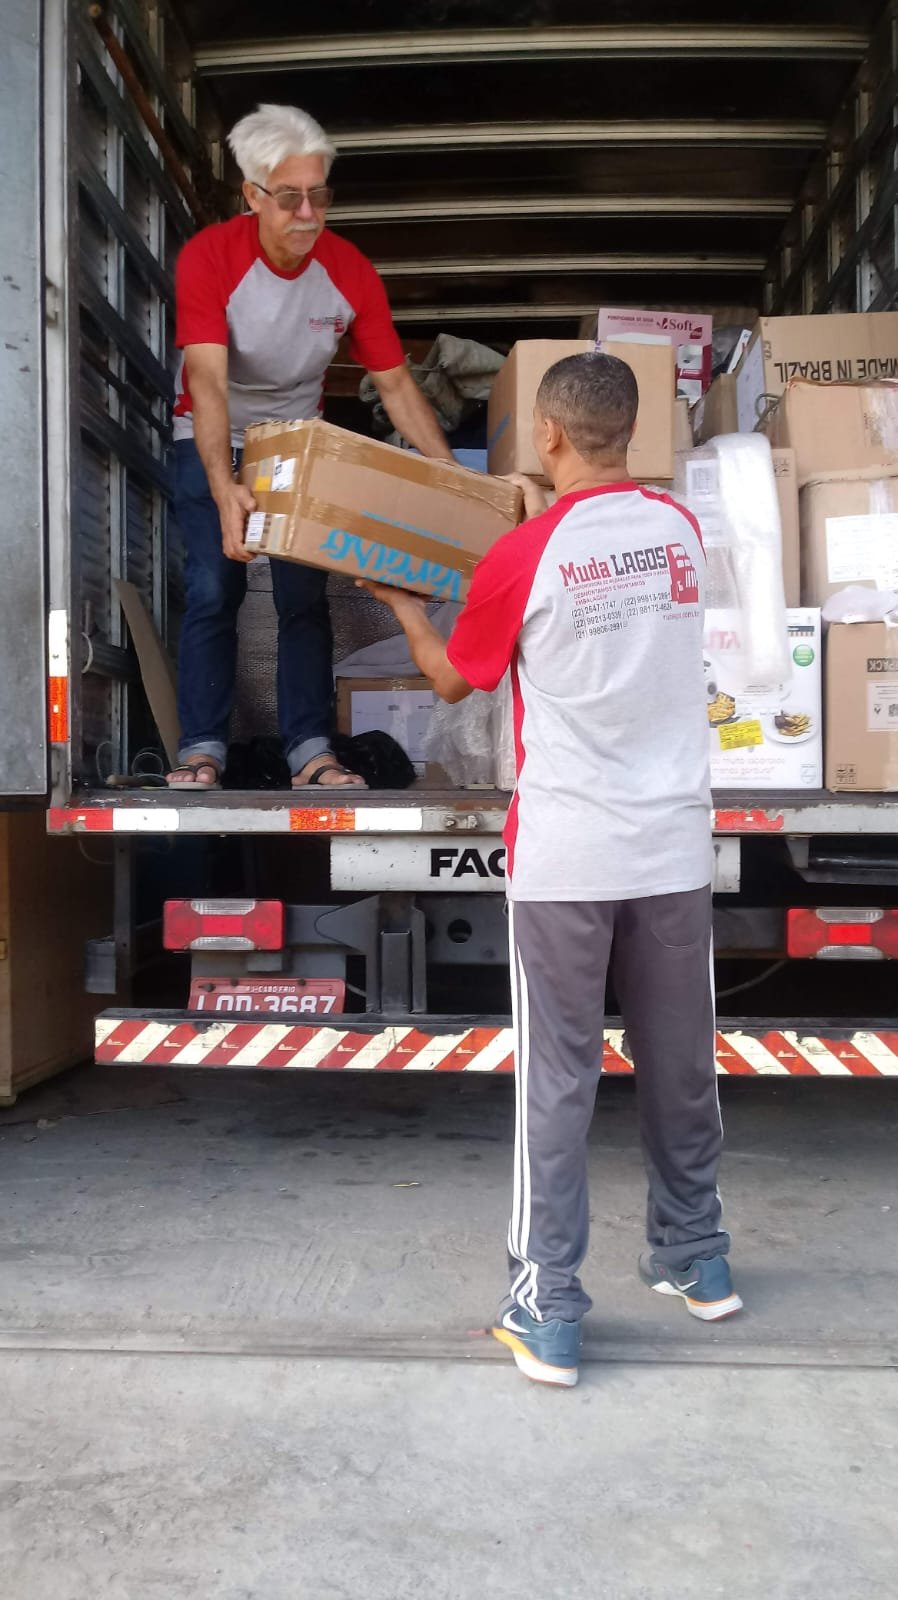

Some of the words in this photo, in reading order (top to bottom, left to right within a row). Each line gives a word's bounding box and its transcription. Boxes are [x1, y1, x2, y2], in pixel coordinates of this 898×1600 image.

[669, 318, 693, 331] Soft
[774, 360, 832, 383] BRAZIL
[837, 359, 852, 379] IN
[559, 557, 611, 587] Muda
[610, 546, 668, 576] LAGOS
[867, 658, 898, 672] PACK
